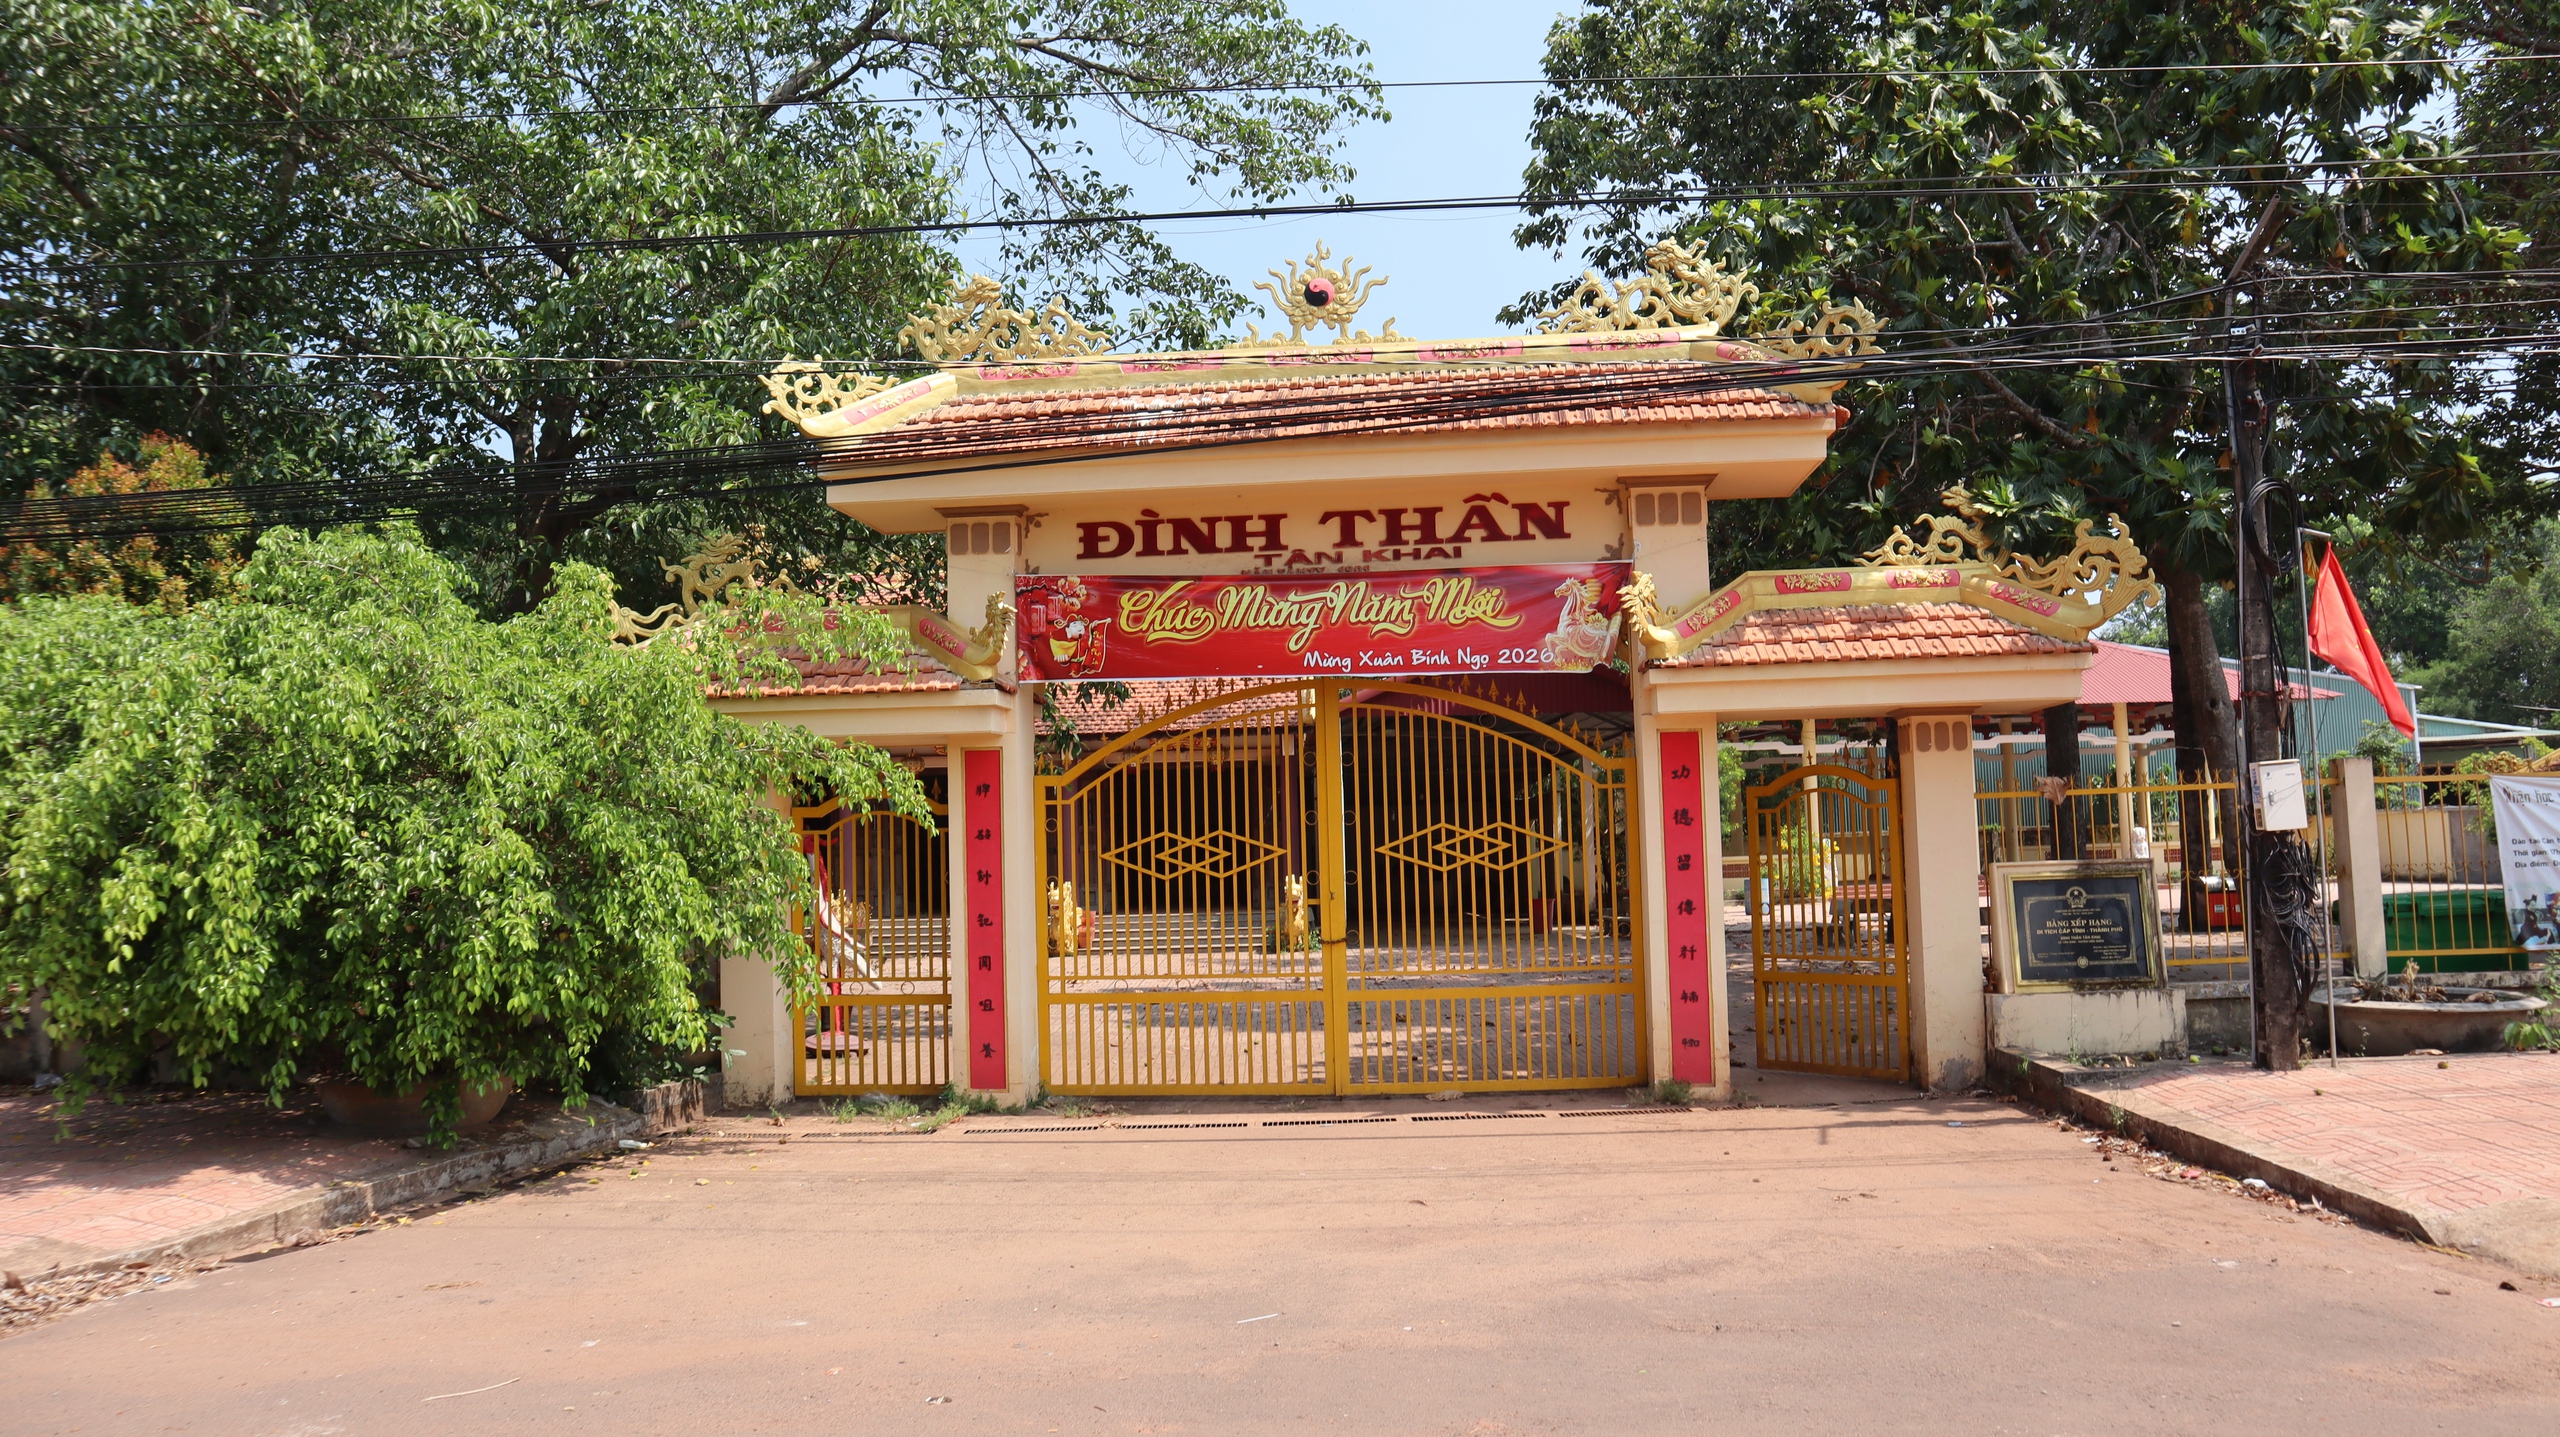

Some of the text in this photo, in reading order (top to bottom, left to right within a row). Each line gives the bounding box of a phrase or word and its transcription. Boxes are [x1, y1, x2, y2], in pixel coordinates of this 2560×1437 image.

[1076, 492, 1571, 560] ĐÌNH THẦN
[1254, 546, 1462, 567] TÂN KHAI
[1118, 576, 1521, 652] Chúc Mừng Năm Mới
[1303, 646, 1555, 673] Mừng Xuân Bính Ngọ 2026
[2534, 788, 2554, 806] học
[2071, 917, 2087, 927] XẾP
[2089, 918, 2112, 928] HẠNG
